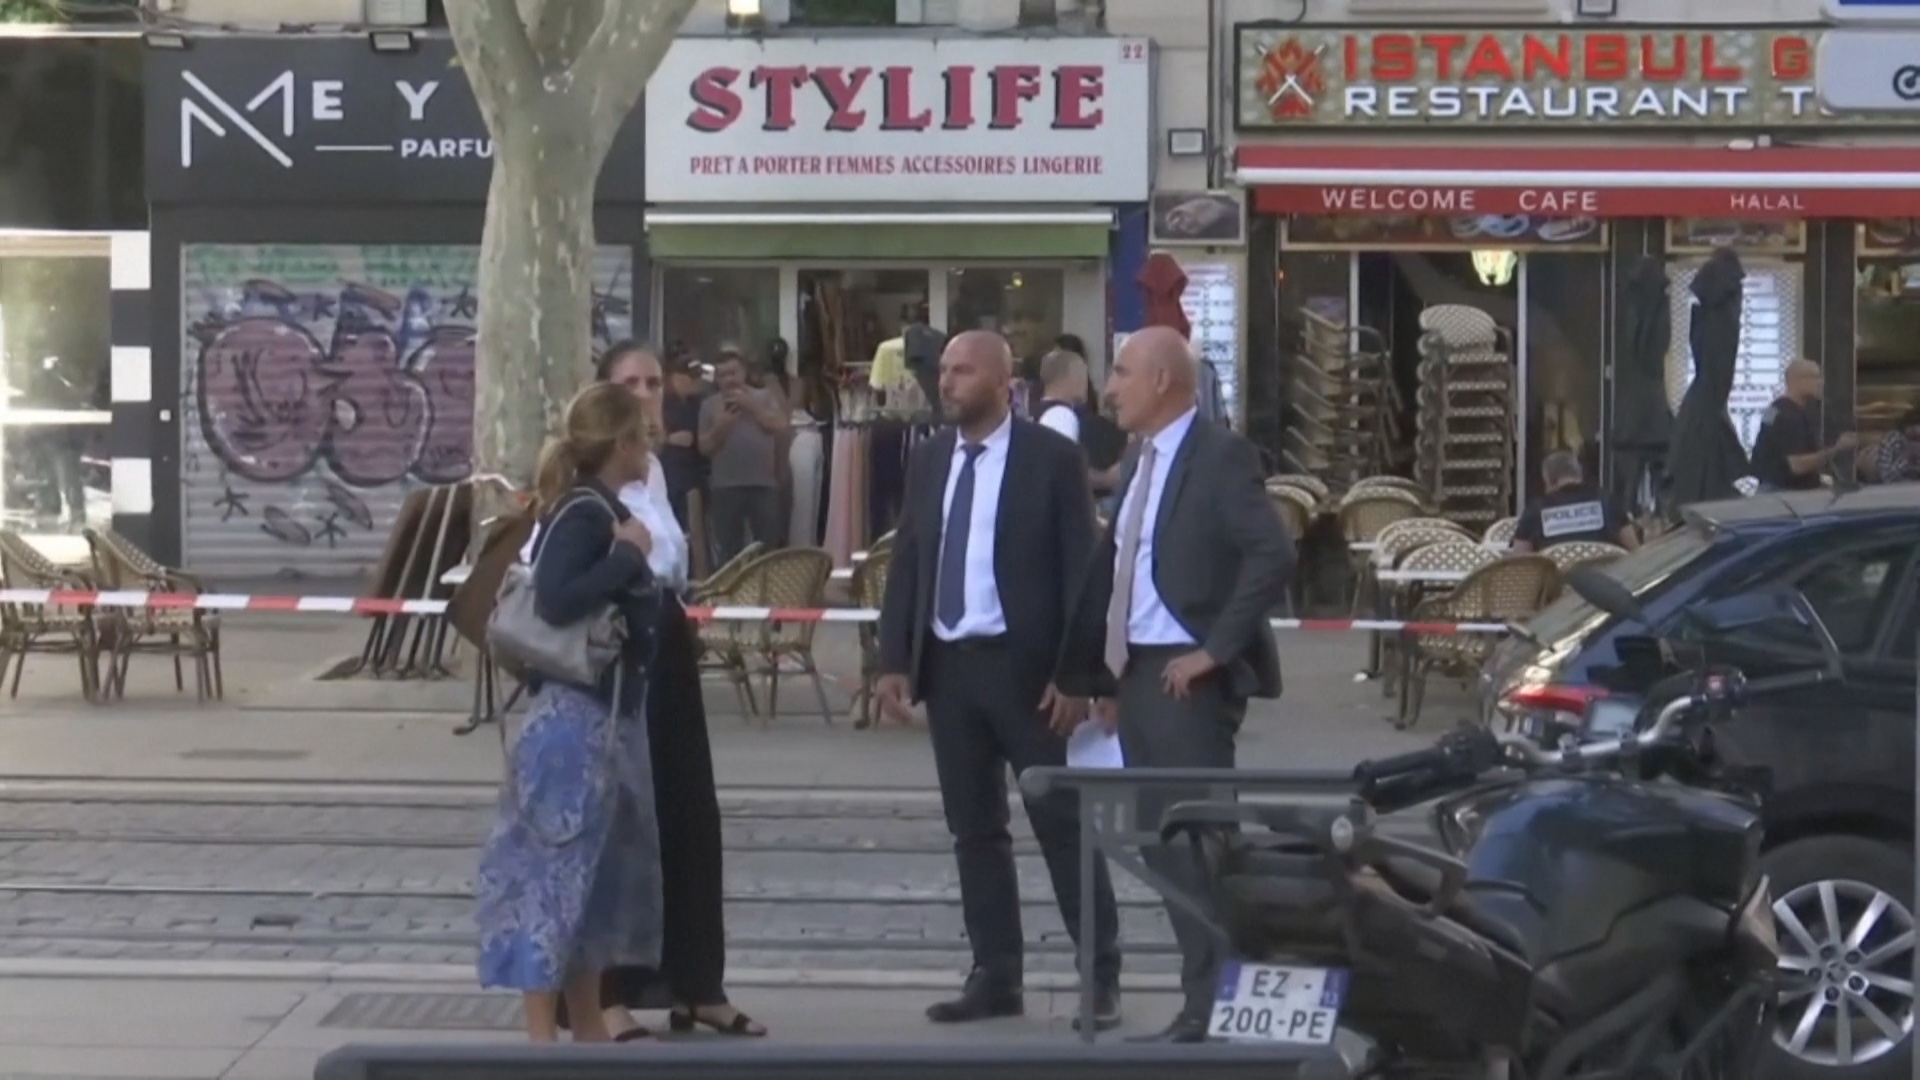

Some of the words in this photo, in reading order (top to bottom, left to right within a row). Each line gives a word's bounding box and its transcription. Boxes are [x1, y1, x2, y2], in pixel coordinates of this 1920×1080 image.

[1122, 44, 1144, 60] 22
[1344, 33, 1743, 81] ISTANBUL
[686, 65, 1104, 132] STYLIFE
[1344, 86, 1748, 117] RESTAURANT
[690, 156, 734, 175] PRET
[737, 156, 749, 175] A
[753, 156, 821, 175] PORTER
[826, 156, 895, 175] FEMMES
[901, 156, 1016, 175] ACCESSOIRES
[1023, 156, 1102, 175] LINGERIE
[1321, 188, 1476, 210] WELCOME
[1518, 189, 1598, 212] CAFE
[1730, 194, 1805, 210] HALAL
[1218, 1005, 1328, 1039] 200-PE
